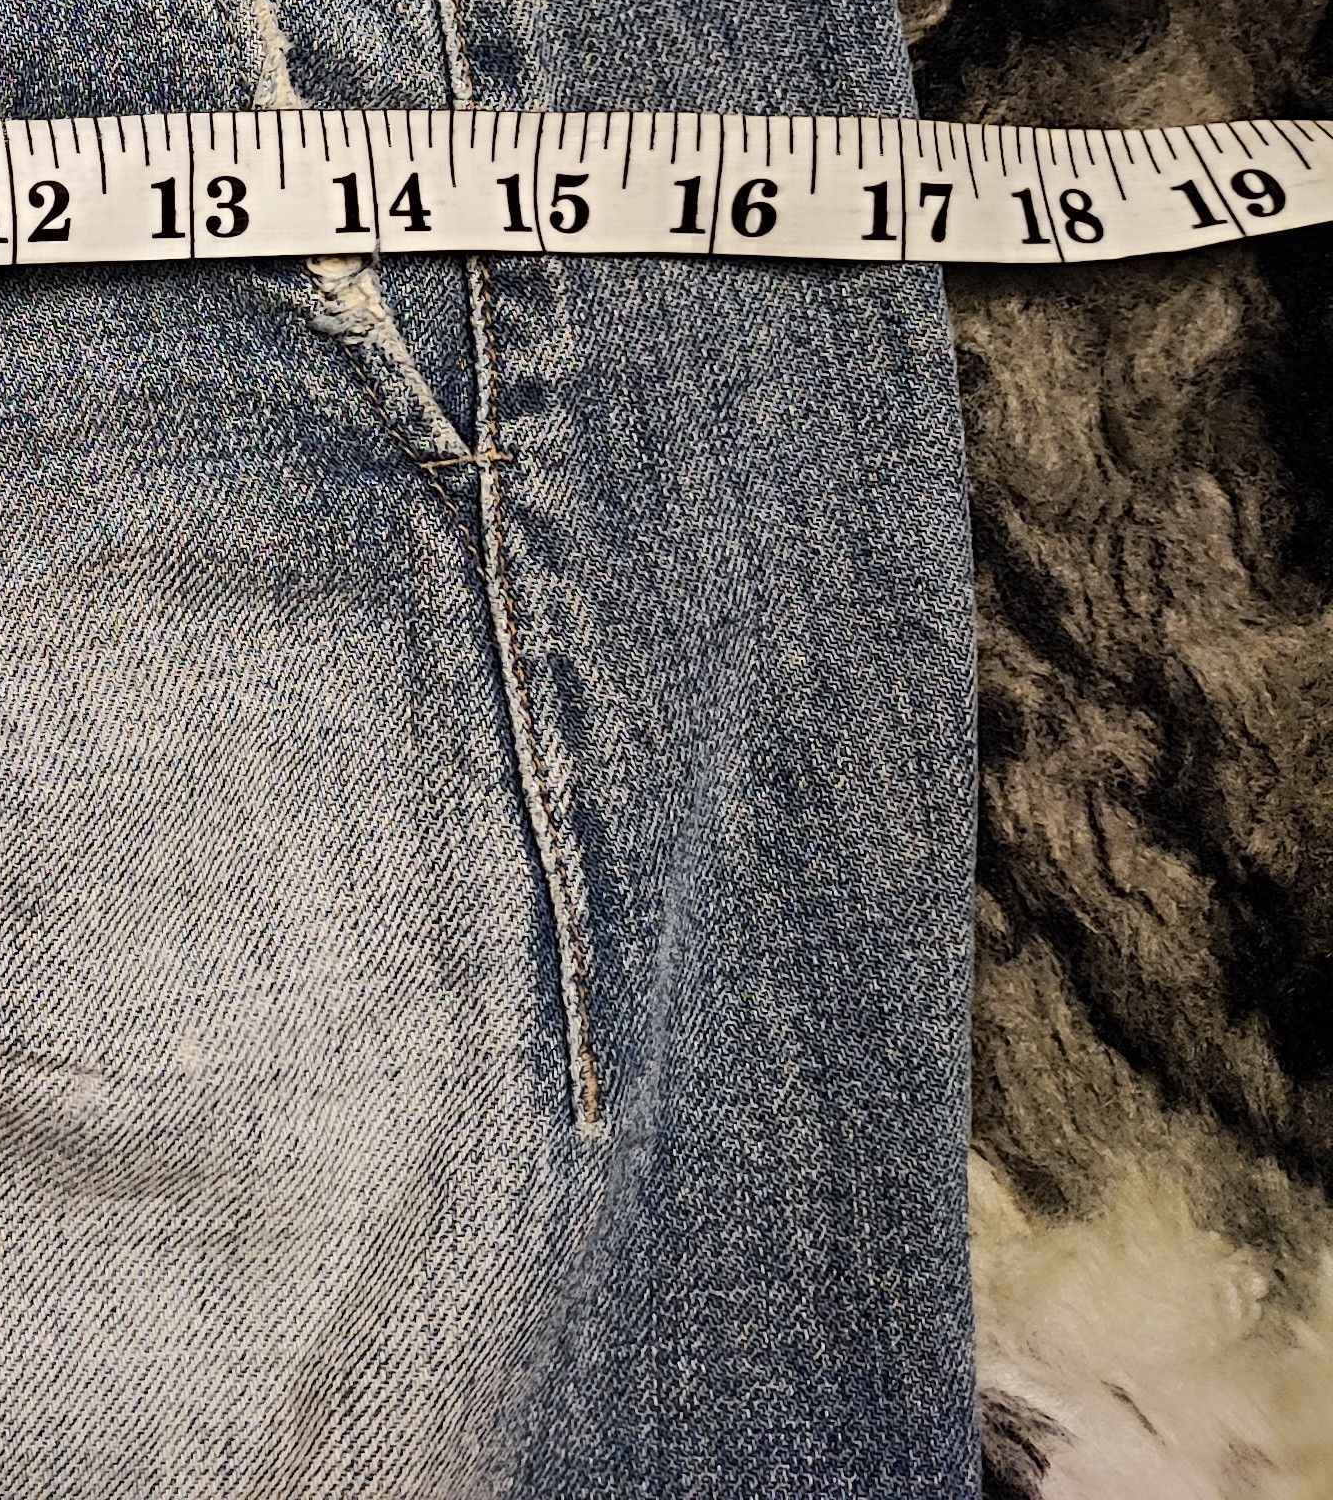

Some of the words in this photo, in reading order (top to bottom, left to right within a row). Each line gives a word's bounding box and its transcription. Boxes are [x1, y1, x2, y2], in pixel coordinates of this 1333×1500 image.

[150, 176, 250, 239] 13
[333, 172, 432, 233] 14
[496, 173, 589, 235] 15
[668, 178, 779, 238] 16
[859, 180, 954, 243] 17
[1009, 188, 1105, 246] 18
[1171, 167, 1287, 231] 19
